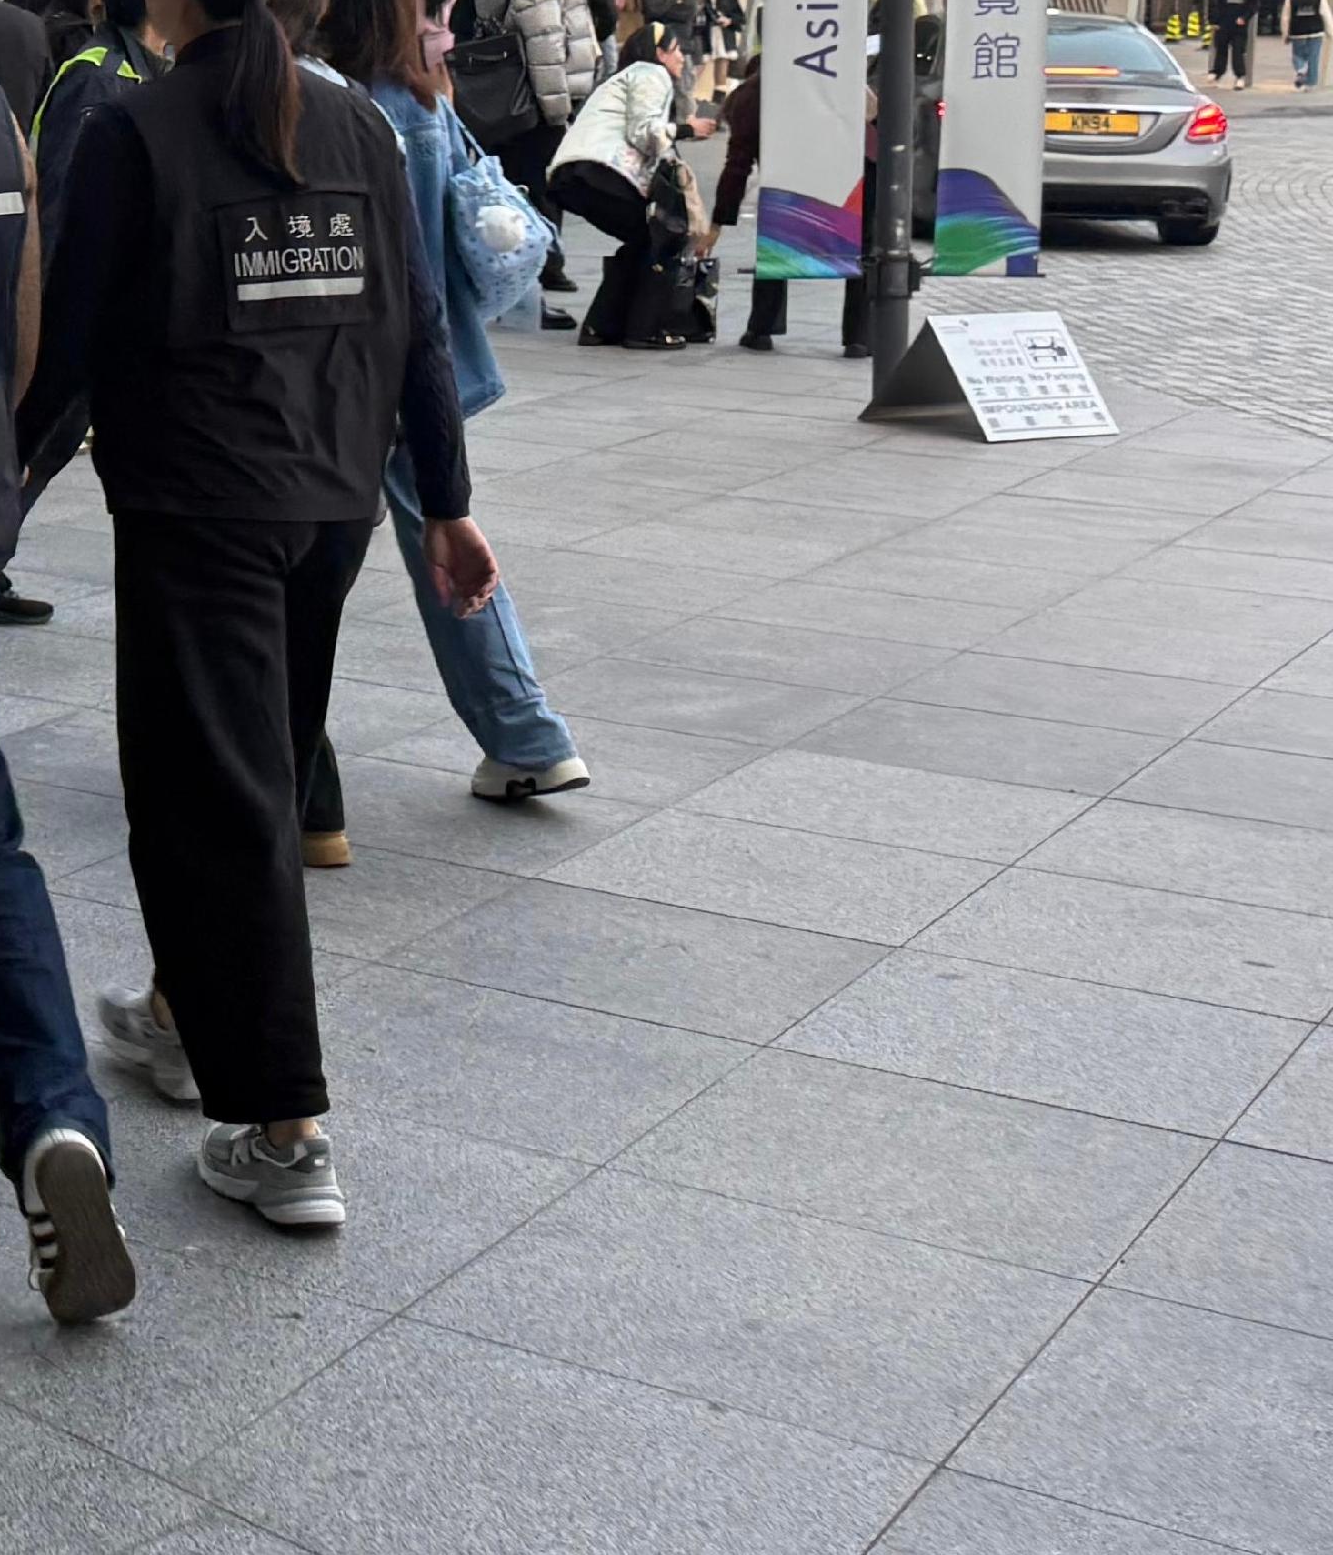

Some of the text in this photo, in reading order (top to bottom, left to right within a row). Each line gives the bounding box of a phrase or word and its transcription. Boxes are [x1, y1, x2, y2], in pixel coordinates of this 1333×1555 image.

[244, 213, 355, 243] 入境處
[234, 245, 365, 277] IMMIGRATION
[1064, 399, 1099, 411] AREA
